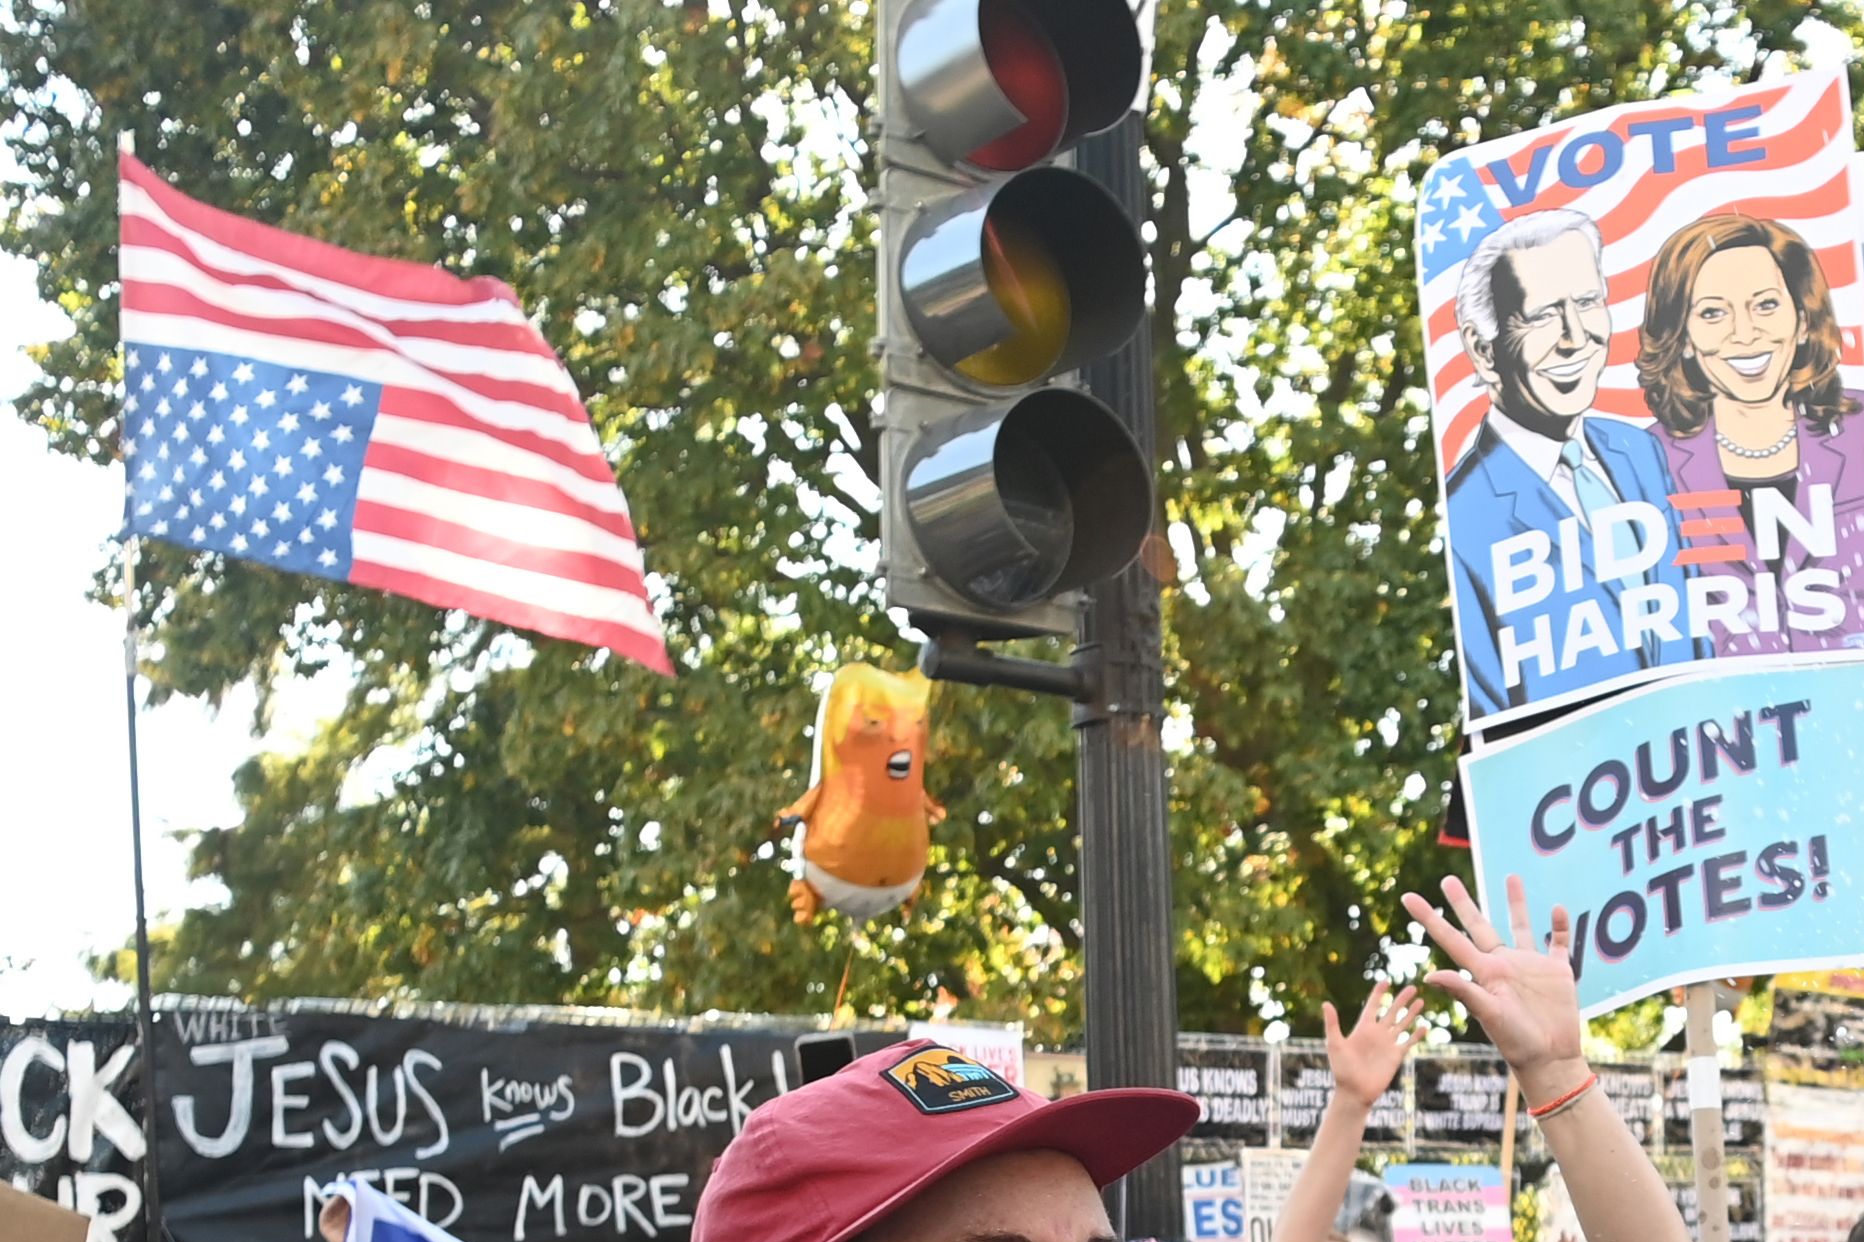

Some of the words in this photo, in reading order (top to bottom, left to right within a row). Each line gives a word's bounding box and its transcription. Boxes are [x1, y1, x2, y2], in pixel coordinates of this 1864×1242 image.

[1486, 104, 1766, 208] VOTE
[1490, 483, 1837, 617] BIDEN
[1498, 568, 1847, 689] HARRIS
[1530, 699, 1811, 857] COUNT
[1611, 794, 1726, 876] THE
[174, 1009, 291, 1045] WHITE
[0, 1036, 147, 1163] CK
[171, 1036, 449, 1158] JESUS
[609, 1043, 755, 1137] Black
[948, 1086, 992, 1102] SMITH
[1203, 1068, 1257, 1095] KNOWS
[1296, 1068, 1336, 1088] JESU
[304, 1167, 464, 1239] NED
[514, 1173, 693, 1242] MORE
[1409, 1178, 1482, 1194] BLACK
[1412, 1199, 1485, 1214] TRANS
[1193, 1197, 1244, 1238] ES
[1422, 1221, 1484, 1237] LIVES
